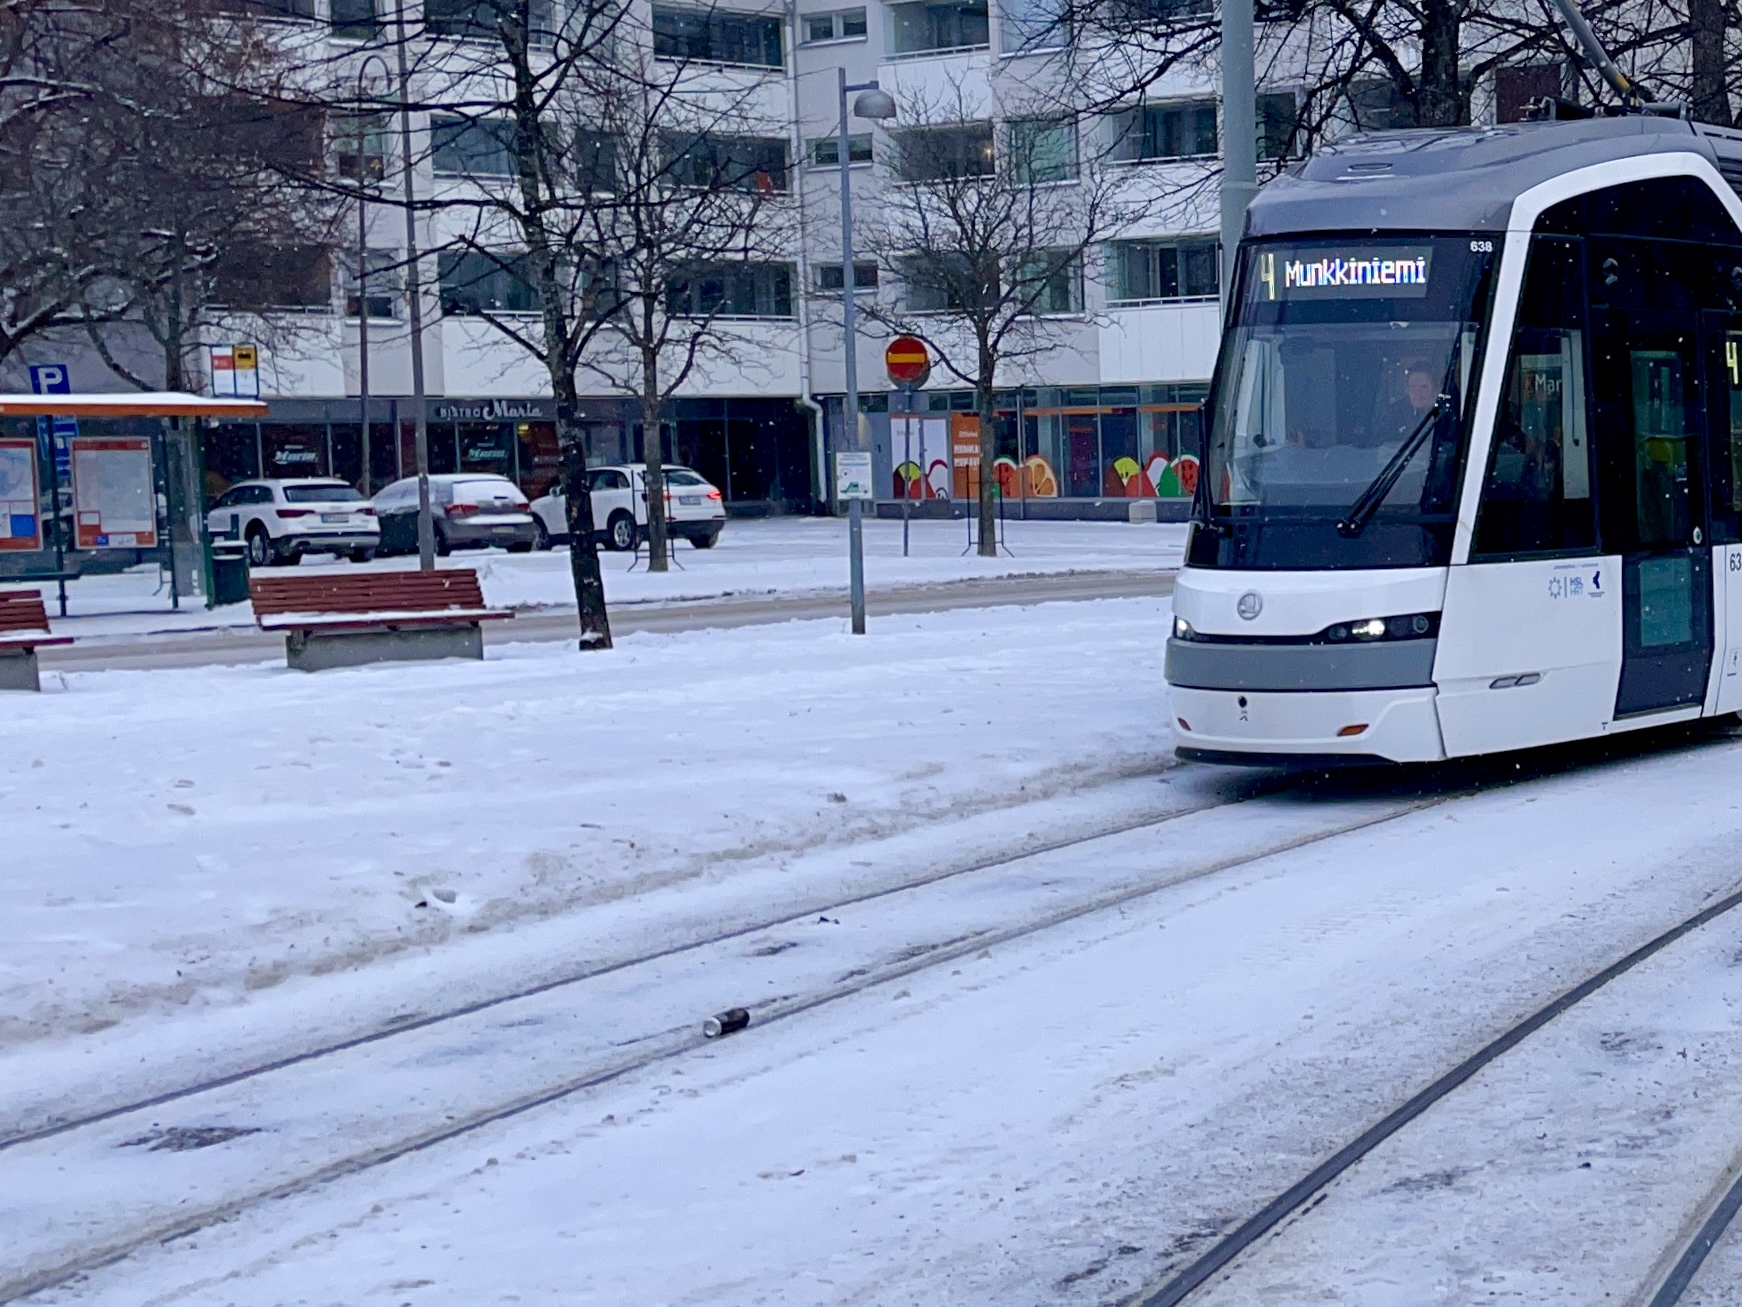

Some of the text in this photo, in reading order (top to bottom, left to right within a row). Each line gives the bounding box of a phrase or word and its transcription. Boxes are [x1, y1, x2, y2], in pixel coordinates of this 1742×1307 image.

[1470, 241, 1494, 253] 638
[1260, 252, 1427, 300] 4 Munkkiniemi
[1726, 341, 1739, 385] 4
[37, 367, 63, 394] P
[482, 398, 542, 421] Maria
